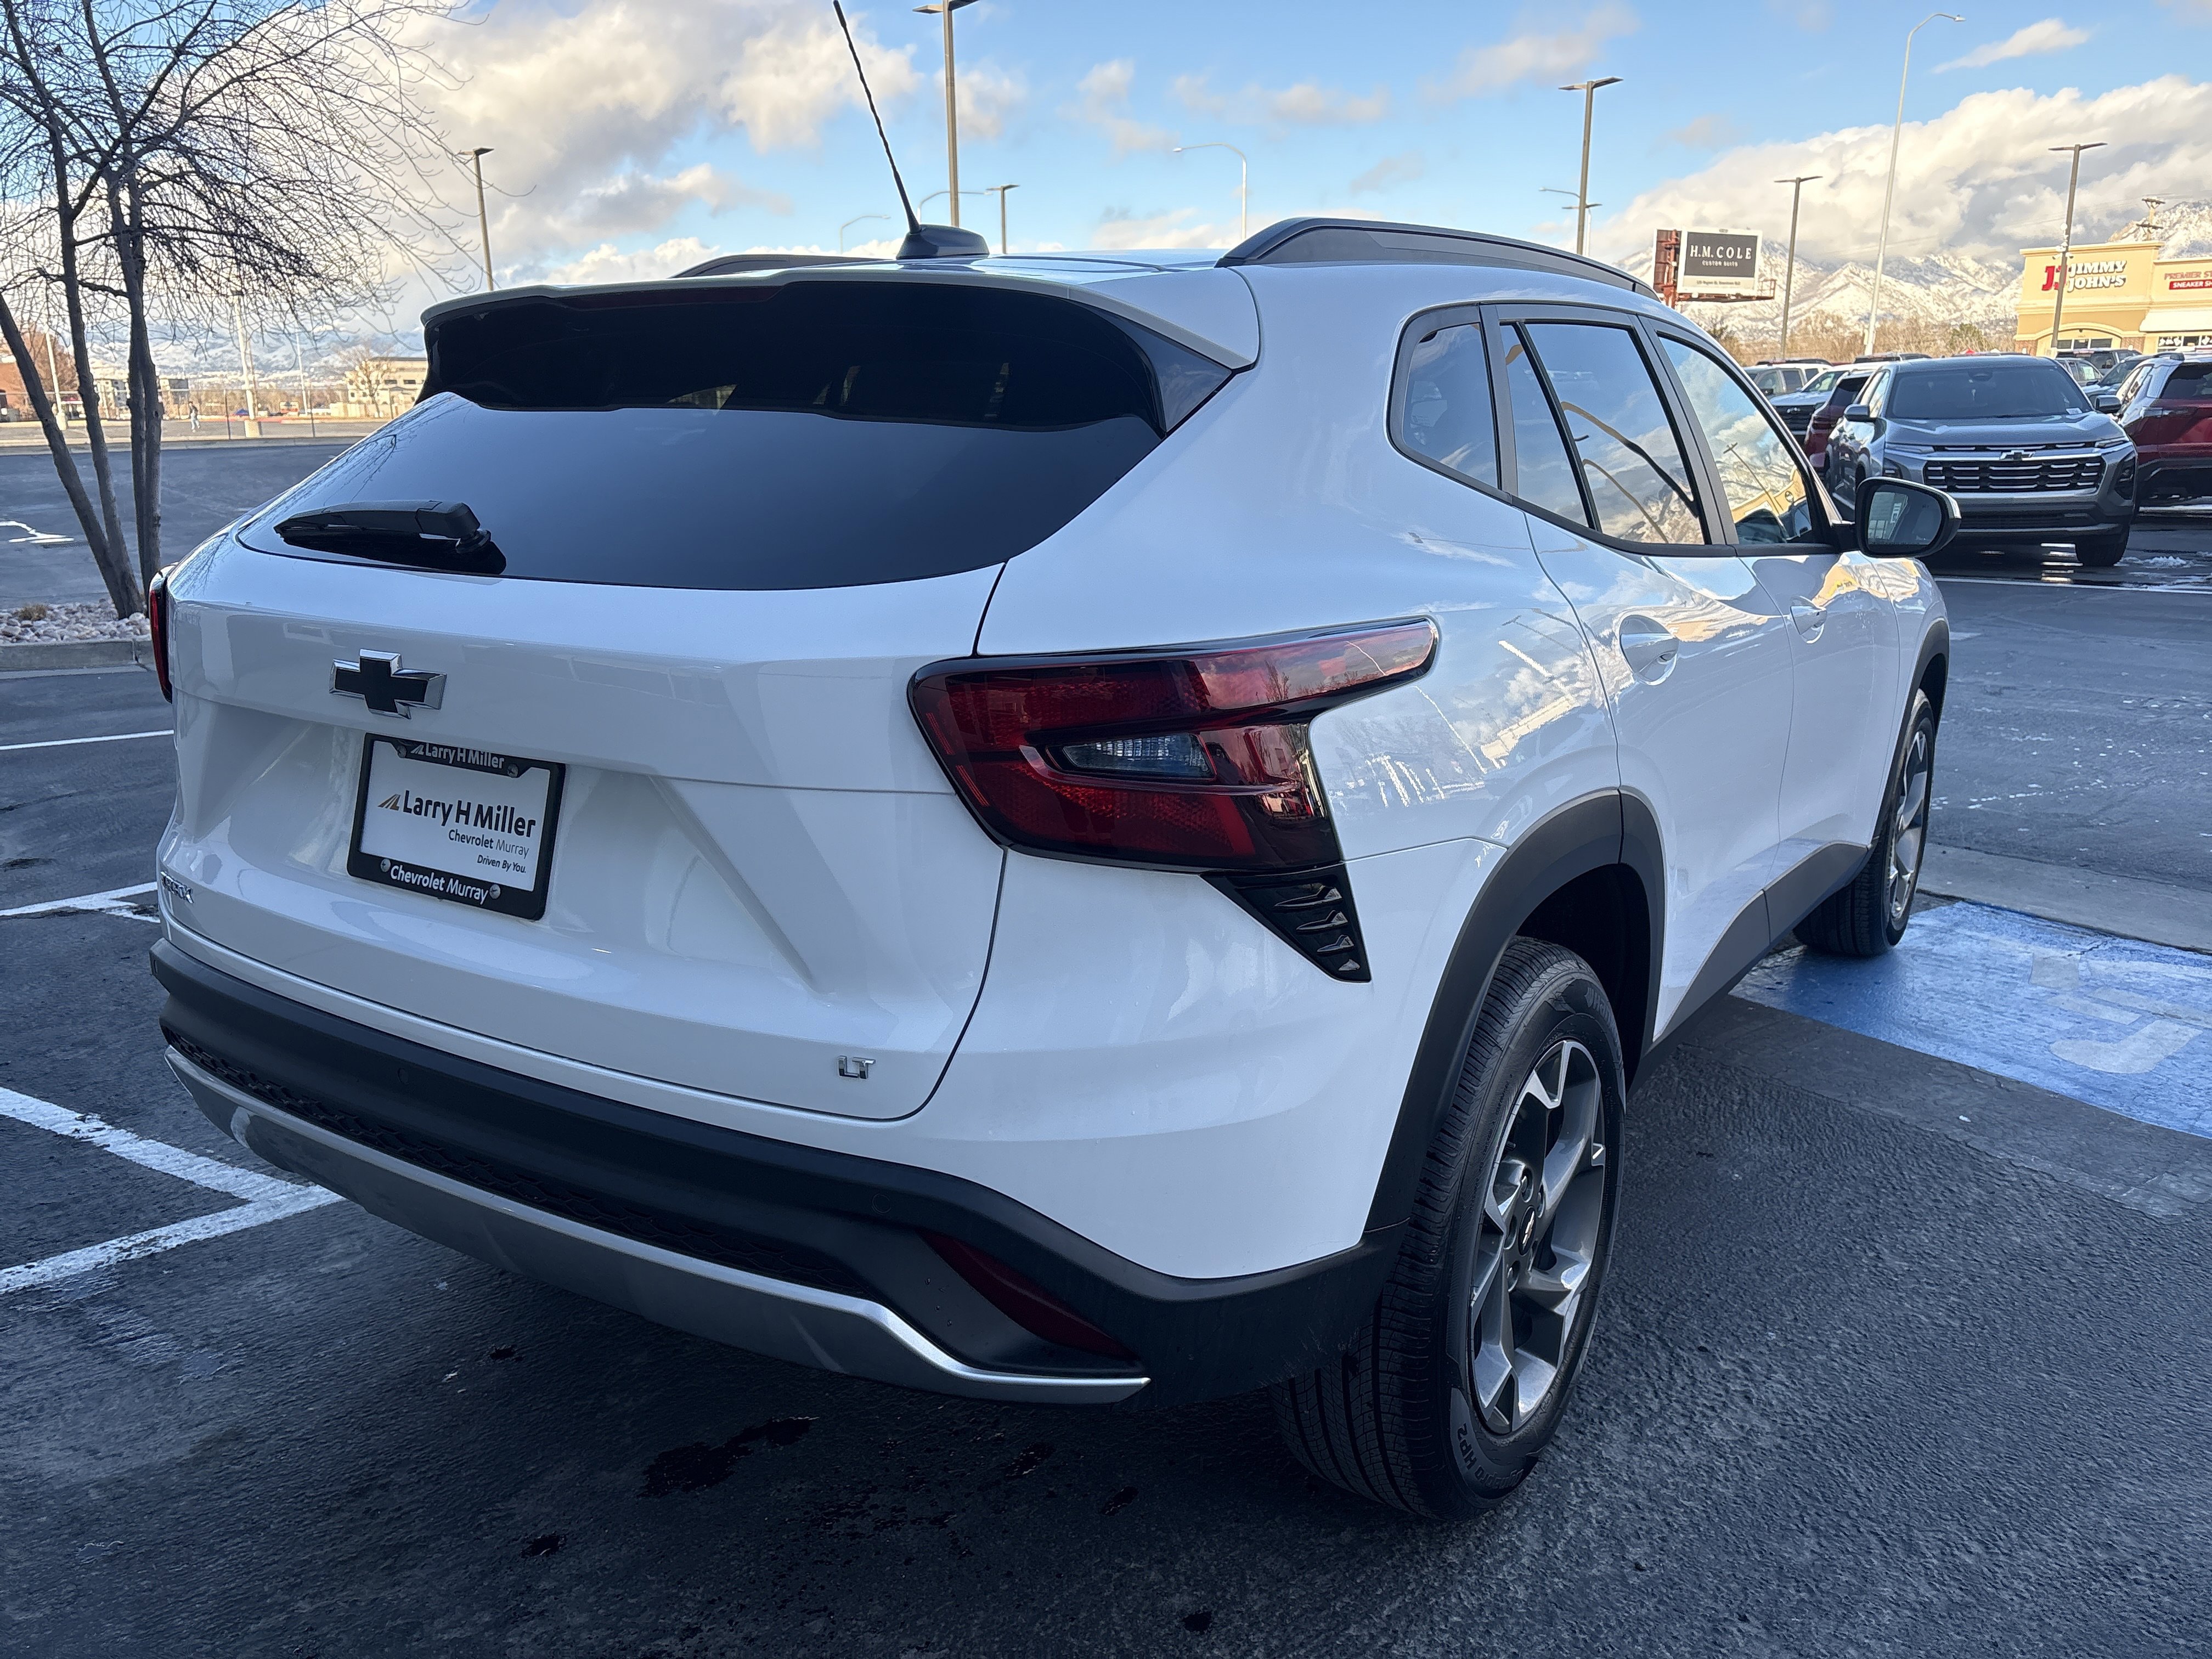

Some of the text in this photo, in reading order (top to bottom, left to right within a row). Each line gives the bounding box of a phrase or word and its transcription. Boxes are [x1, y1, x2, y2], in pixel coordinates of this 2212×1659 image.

[1716, 246, 1752, 259] COLE
[2068, 261, 2127, 278] JIMMY
[2067, 275, 2126, 293] JOHN'S
[425, 743, 505, 769] Larry H Miller
[403, 790, 536, 838] Larry H Miller
[448, 830, 529, 858] Chevrolet Murray
[477, 854, 526, 873] Driven By You.
[391, 865, 488, 905] Chevrolet Murray
[838, 1055, 876, 1080] LT
[1457, 1423, 1477, 1470] HP2
